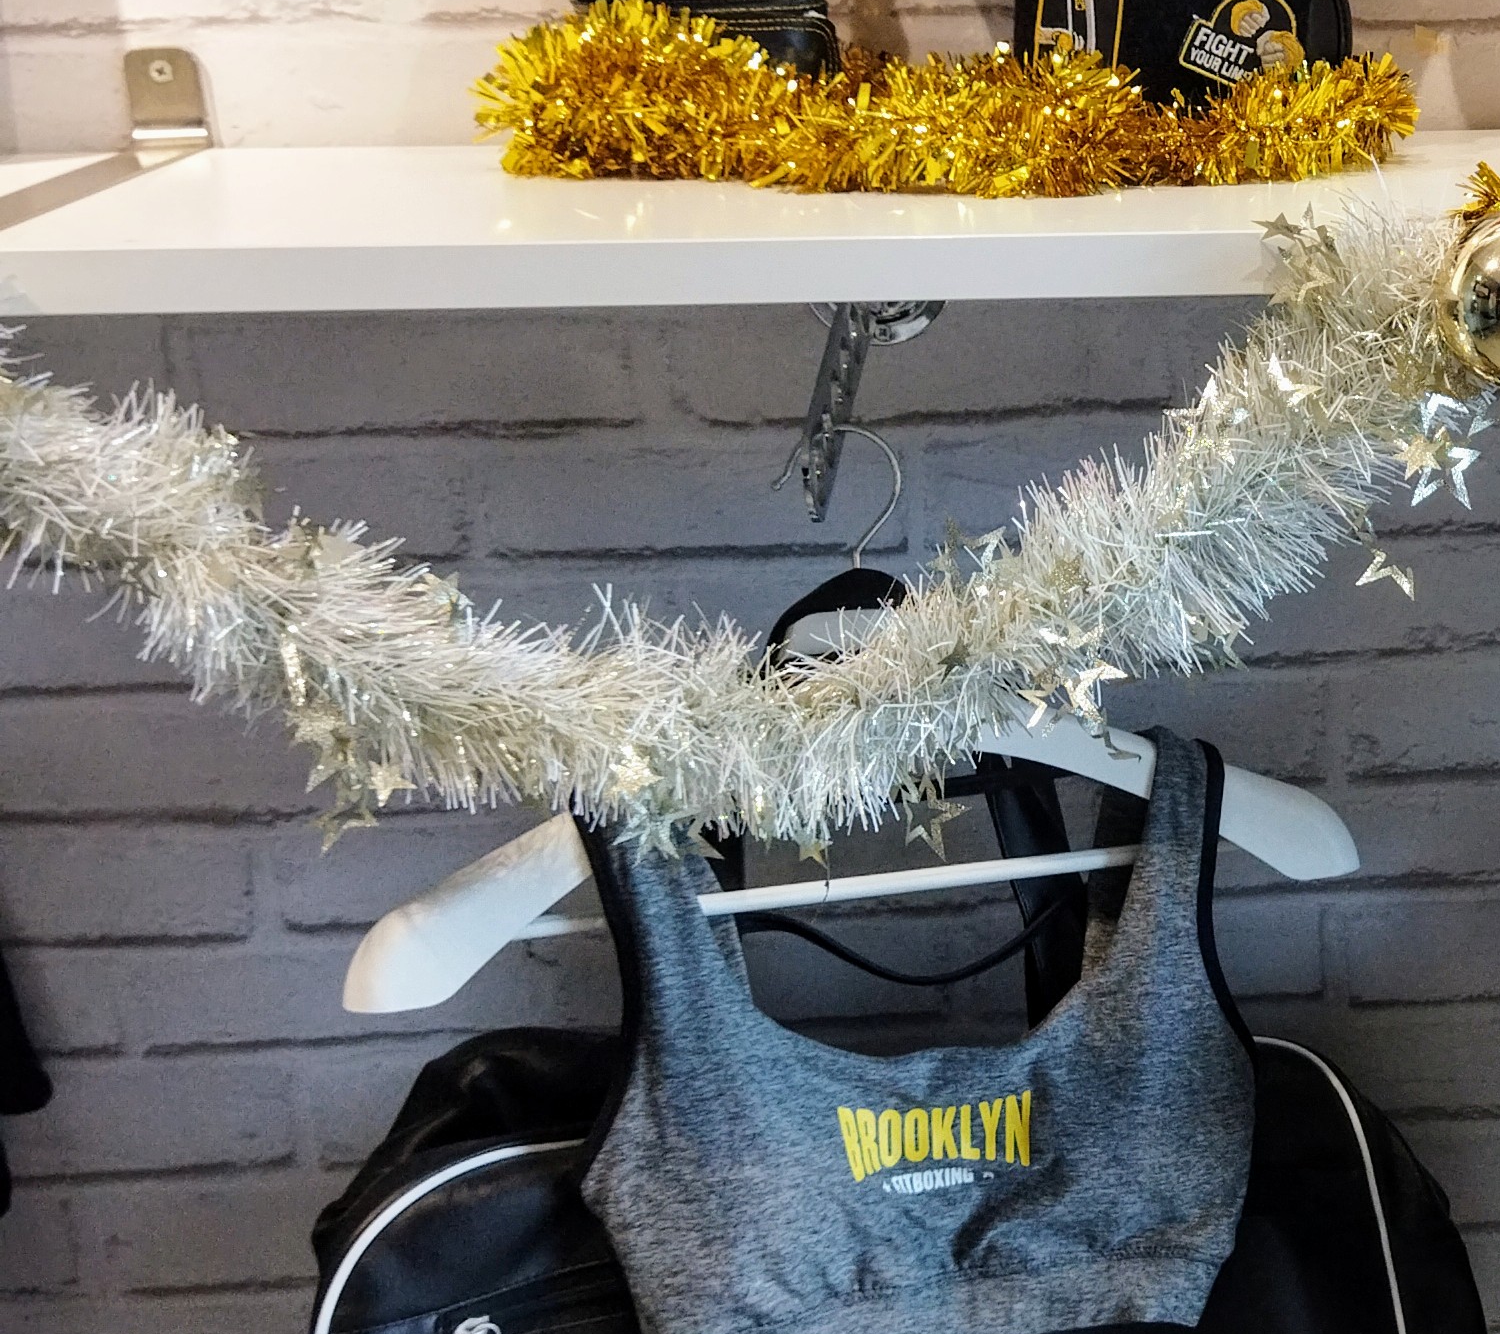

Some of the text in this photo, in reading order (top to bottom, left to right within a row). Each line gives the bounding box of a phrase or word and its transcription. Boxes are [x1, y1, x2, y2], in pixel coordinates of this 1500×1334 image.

[1190, 47, 1223, 73] YOUR
[1193, 26, 1255, 65] FIGHT
[837, 1089, 1032, 1183] BROOKLYN
[890, 1167, 975, 1195] FITBOXING
